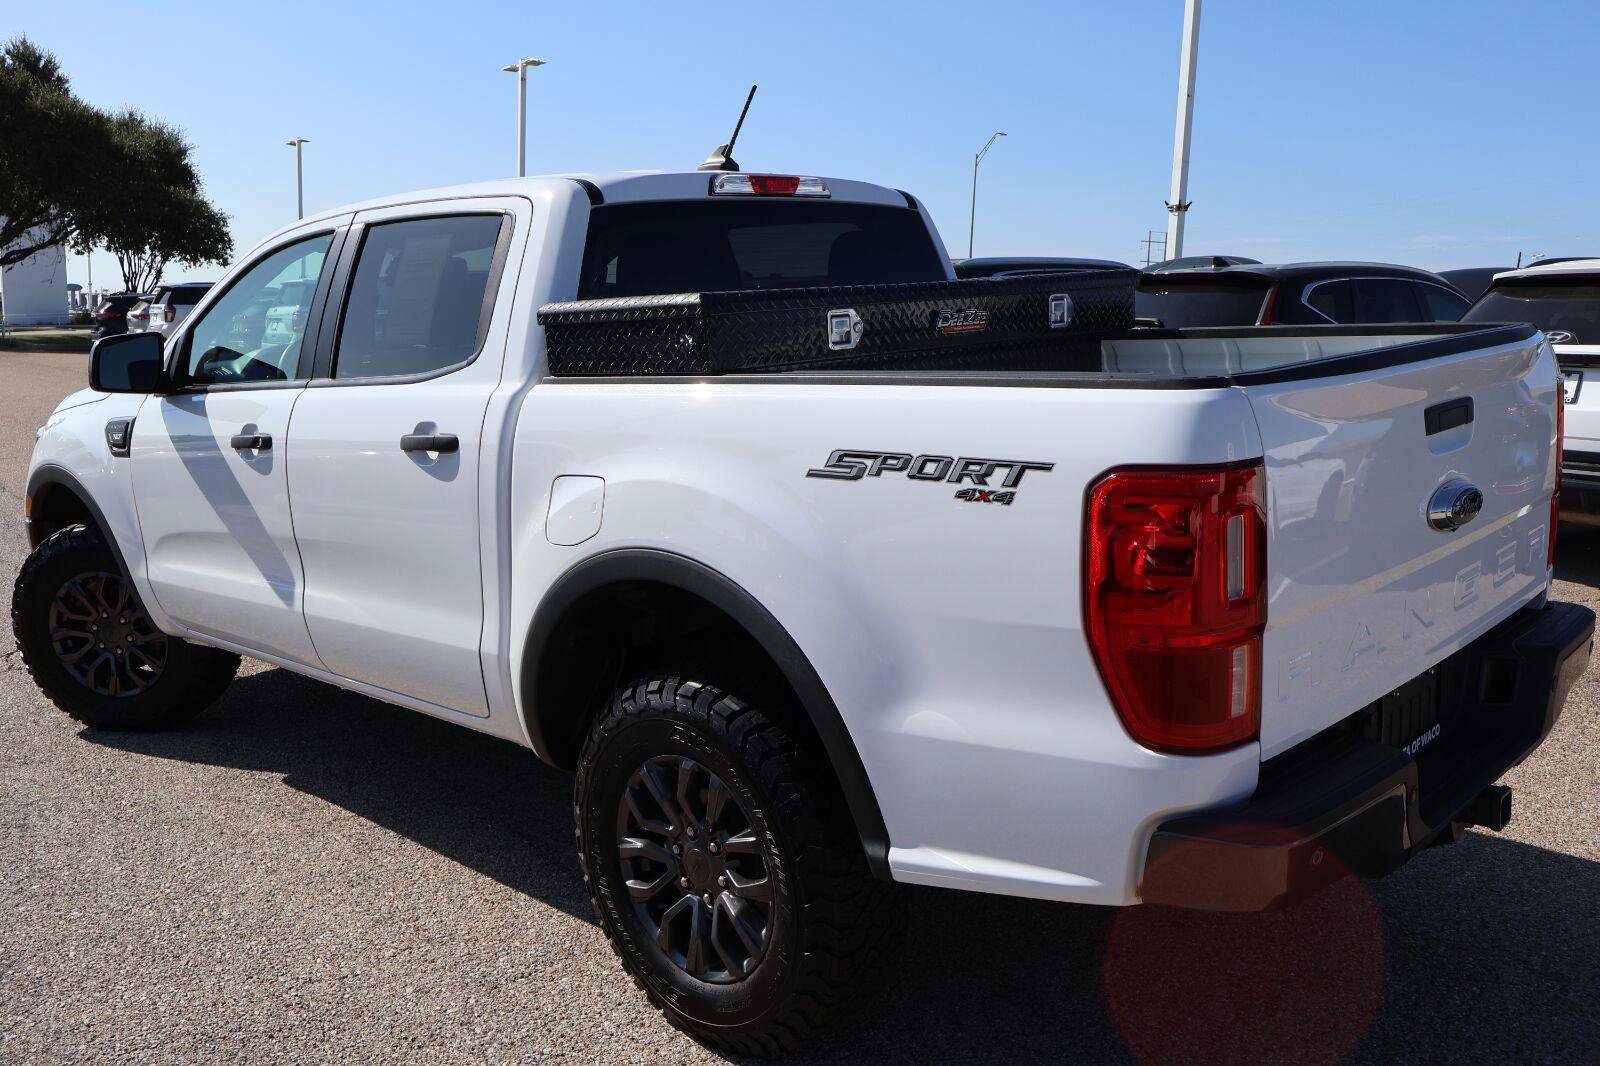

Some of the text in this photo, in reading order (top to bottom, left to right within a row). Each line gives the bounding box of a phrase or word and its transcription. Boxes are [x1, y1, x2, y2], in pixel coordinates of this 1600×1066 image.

[805, 448, 1055, 488] SPORT
[1277, 523, 1546, 703] RANGER
[1411, 737, 1420, 753] OF
[1420, 723, 1441, 747] WACO
